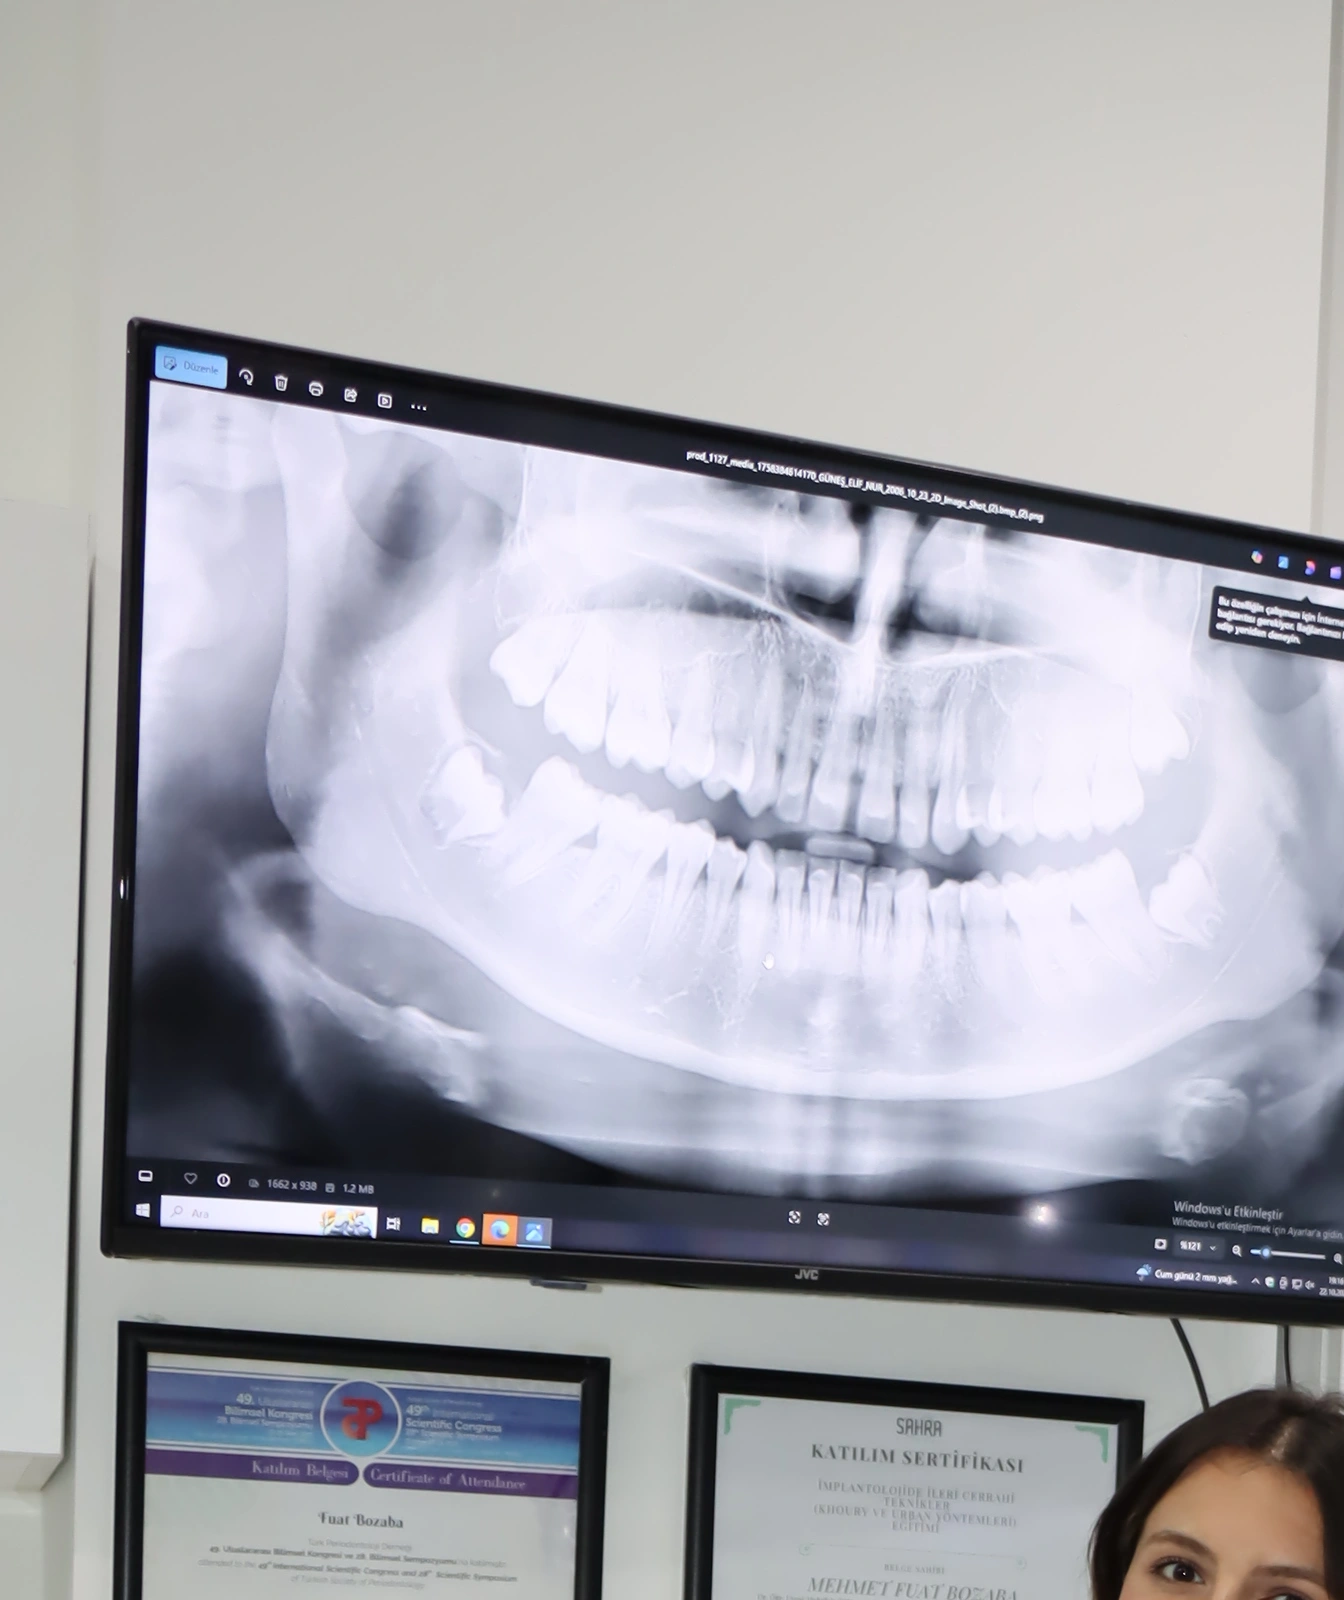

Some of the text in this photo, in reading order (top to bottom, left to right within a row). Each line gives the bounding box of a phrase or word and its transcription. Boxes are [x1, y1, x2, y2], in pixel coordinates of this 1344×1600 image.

[184, 360, 219, 375] Düzenle
[268, 1179, 290, 1190] 1662
[291, 1181, 299, 1190] x
[299, 1180, 318, 1191] 938
[358, 1184, 375, 1195] MB
[191, 1209, 209, 1219] Ara
[1173, 1200, 1283, 1222] Windows'u Etkinleştir
[1172, 1216, 1215, 1229] Windows'u
[1217, 1221, 1271, 1234] etkinleştirmek
[1272, 1224, 1285, 1236] için
[1287, 1226, 1320, 1240] Ayarlar'a
[794, 1269, 819, 1280] JVC
[1154, 1270, 1172, 1280] Cum
[1173, 1271, 1194, 1282] günü
[1195, 1272, 1201, 1281] 2
[1202, 1274, 1216, 1283] mm
[236, 1393, 255, 1405] 49.
[225, 1405, 313, 1421] Bilimsel Kongresi
[406, 1418, 502, 1433] Scientific Congress
[896, 1417, 942, 1438] SAHRA
[811, 1443, 1024, 1474] KATILIM SERTİFİKASI
[252, 1460, 349, 1481] Katılım Belgesi
[370, 1468, 526, 1490] Certificate of Attendance
[818, 1477, 1015, 1504] İMPLANTOLOJİDE İLERİ CERRAHİ
[813, 1503, 868, 1517] (KHOURY
[872, 1508, 888, 1518] VE
[891, 1509, 932, 1522] URBAN
[884, 1496, 950, 1511] TEKNİKLER
[318, 1510, 404, 1529] Fuat Bozaba
[807, 1577, 894, 1597] MEHMET
[895, 1581, 944, 1600] FUAT
